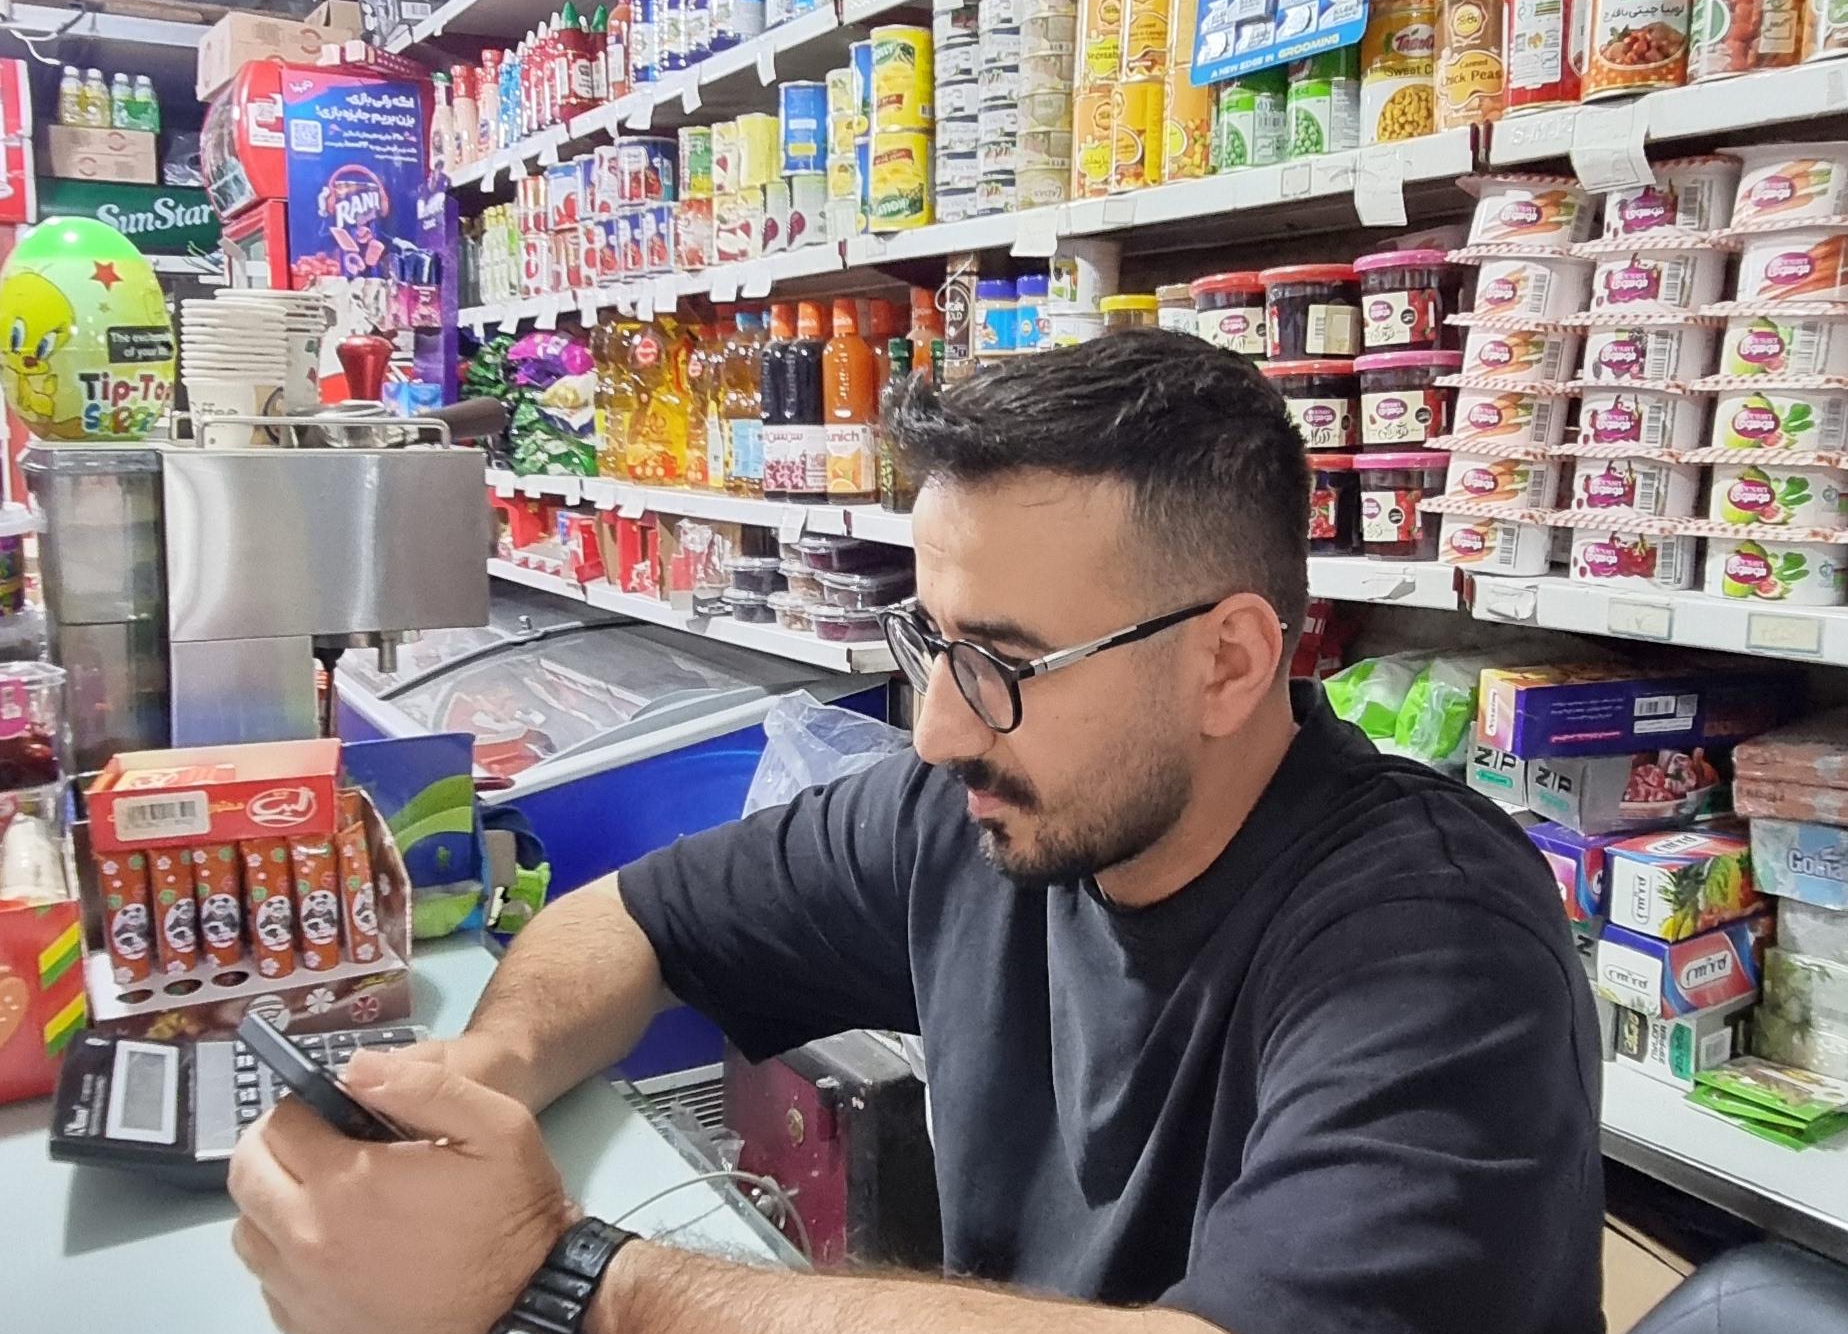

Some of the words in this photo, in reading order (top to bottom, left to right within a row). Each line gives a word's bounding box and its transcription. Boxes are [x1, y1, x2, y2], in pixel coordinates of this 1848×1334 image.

[1278, 33, 1340, 59] GROOMING
[1471, 70, 1503, 82] Peas
[97, 197, 213, 235] SunStar
[336, 191, 381, 229] RANI
[1474, 746, 1517, 771] ZIP
[1535, 767, 1573, 793] ZIP
